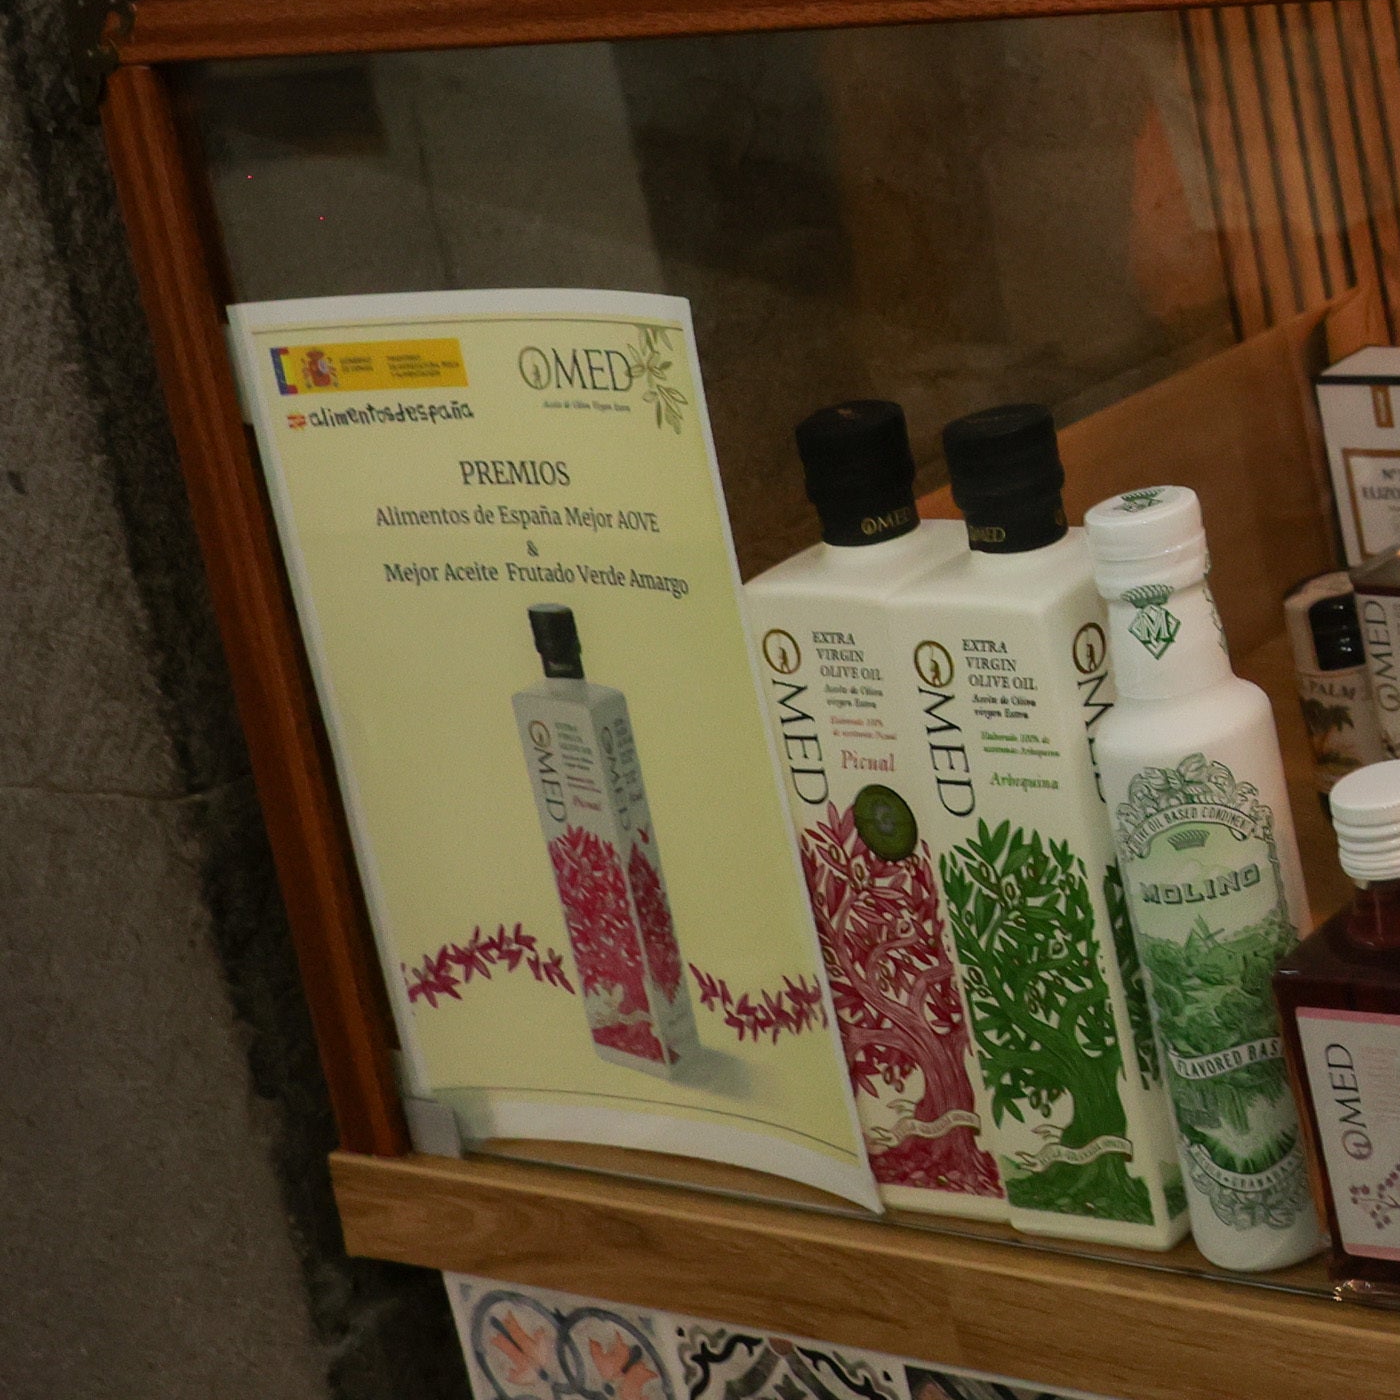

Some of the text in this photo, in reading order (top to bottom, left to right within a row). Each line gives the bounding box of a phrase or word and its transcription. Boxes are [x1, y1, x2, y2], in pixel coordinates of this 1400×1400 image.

[309, 400, 474, 428] alimentosdespaña
[459, 460, 571, 486] PREMIOS
[375, 503, 661, 532] Alimentos de España Mejor AOVE
[525, 540, 538, 557] &
[383, 562, 689, 598] Mejor Aceite Frutado Verde Amargo
[811, 631, 856, 646] EXTRA
[961, 639, 1008, 654] EXTRA
[817, 648, 864, 664] VIRGIN
[965, 656, 1017, 672] VIRGIN
[819, 664, 883, 681] OLIVE OIL
[968, 673, 1037, 690] OLIVE OIL
[1308, 680, 1357, 700] PALM
[840, 749, 896, 774] Picual
[1164, 808, 1199, 824] BASED
[1139, 863, 1260, 904] MOLINO
[1178, 1051, 1243, 1077] FLAVORED
